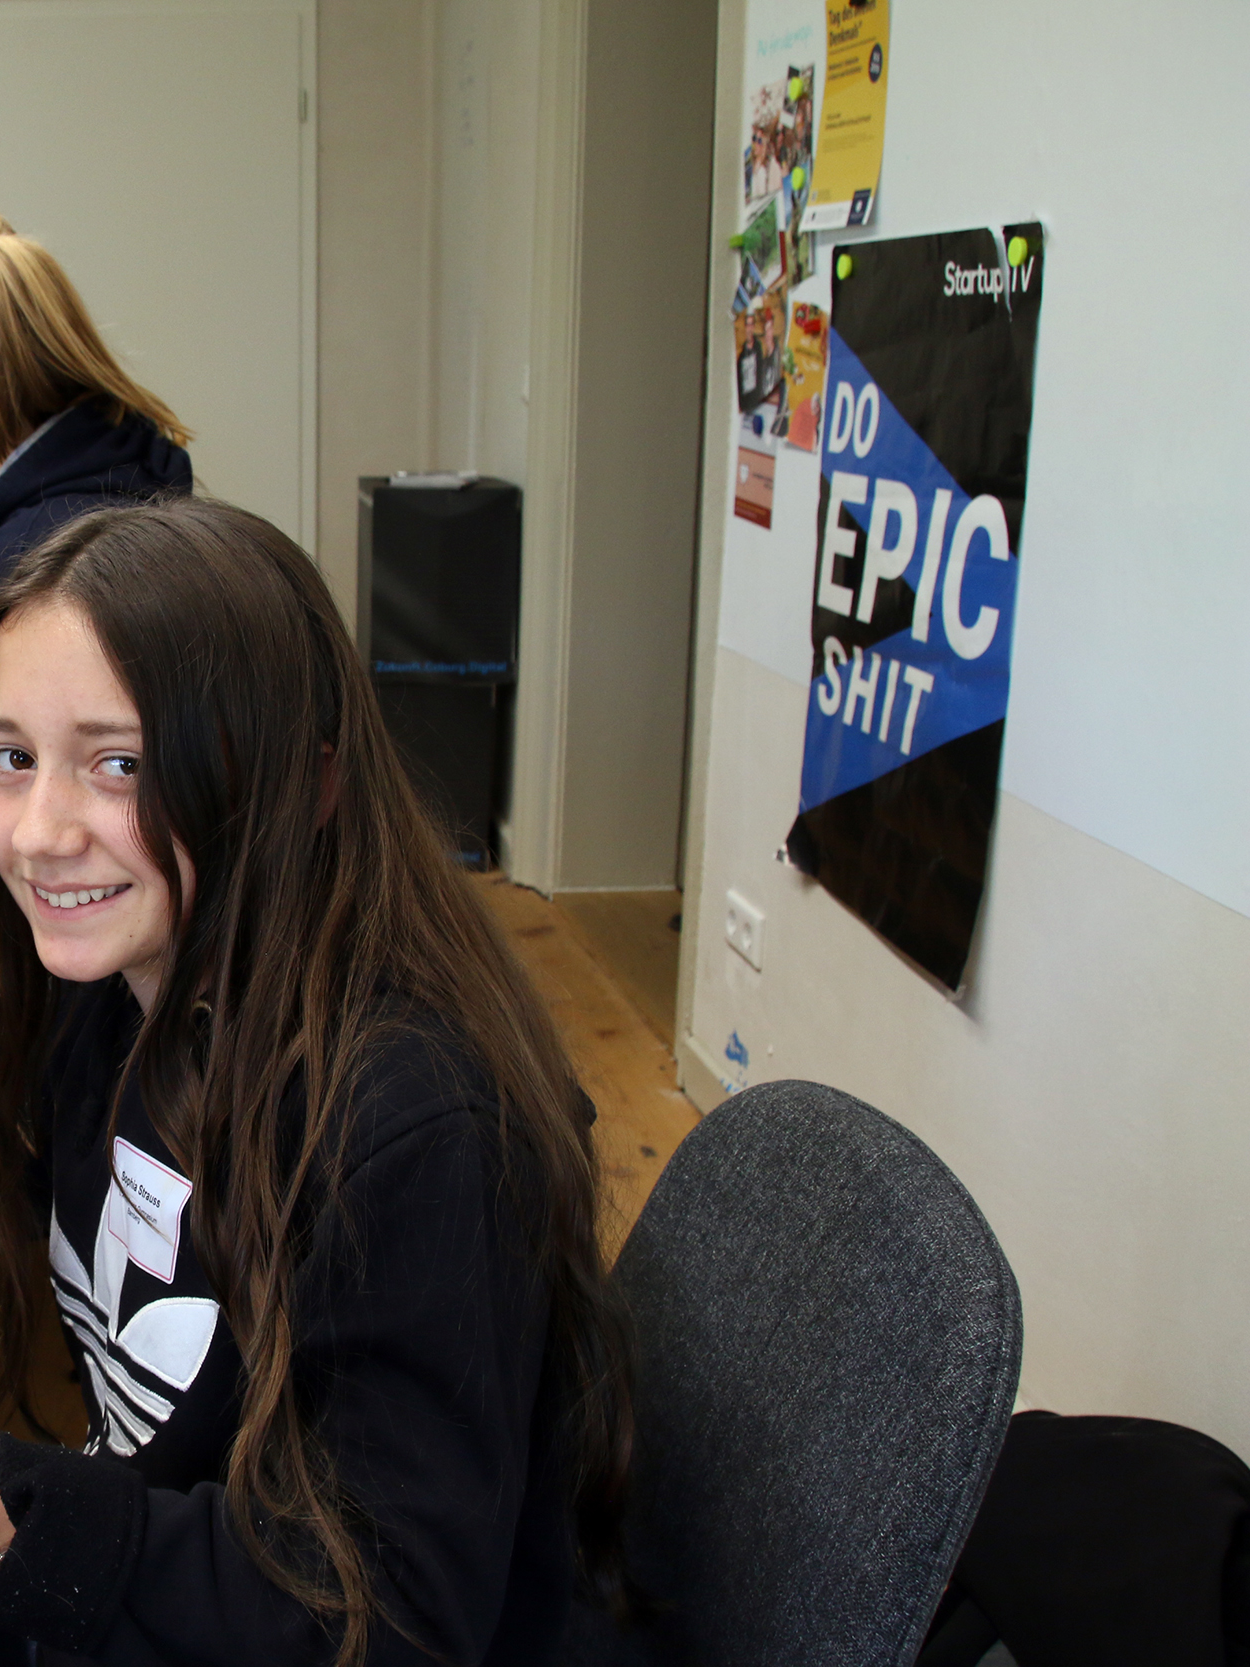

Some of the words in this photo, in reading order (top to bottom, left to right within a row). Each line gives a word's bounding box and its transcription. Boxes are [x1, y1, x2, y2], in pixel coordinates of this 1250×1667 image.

[943, 260, 1004, 303] Startup
[828, 381, 880, 458] DO
[817, 470, 1009, 660] EPIC
[818, 635, 934, 756] SHIT
[121, 1170, 138, 1192] Sophia
[137, 1184, 161, 1208] Strauss
